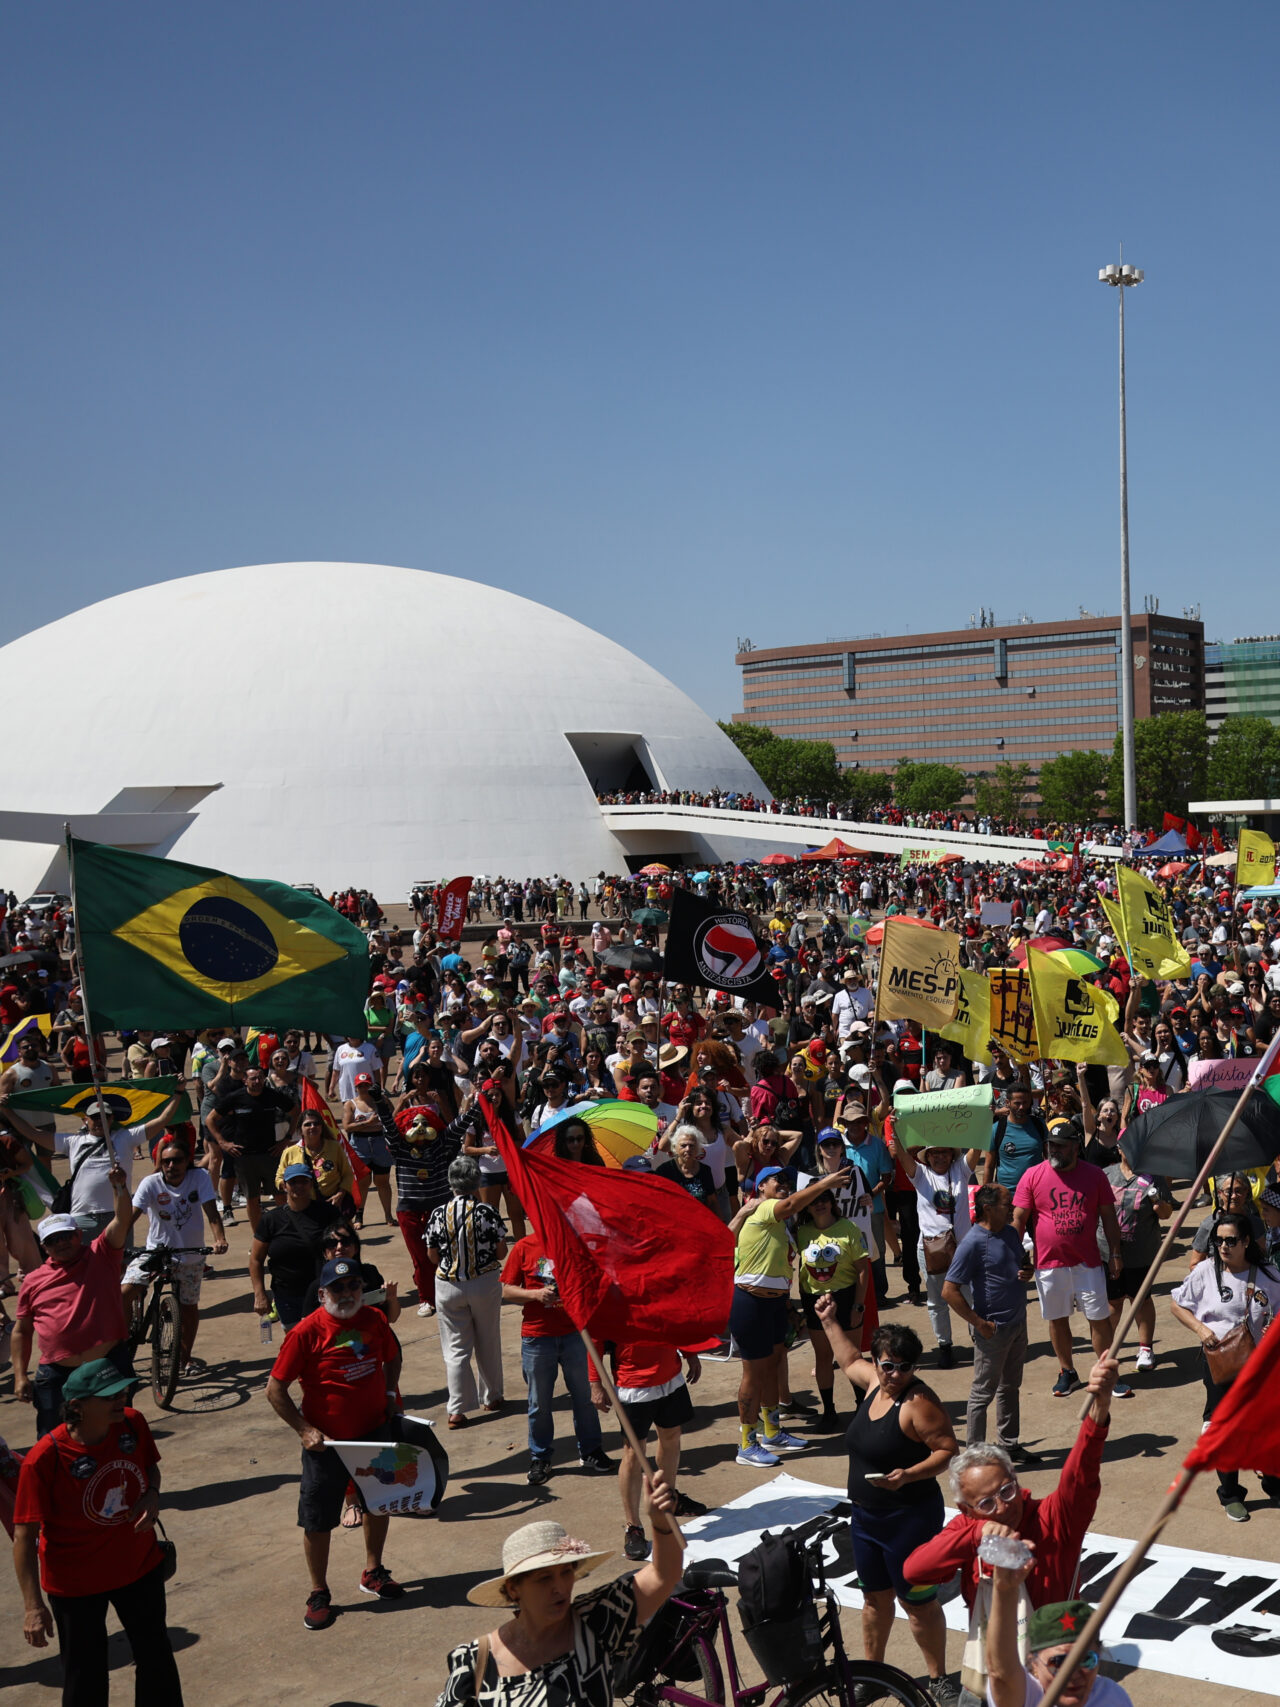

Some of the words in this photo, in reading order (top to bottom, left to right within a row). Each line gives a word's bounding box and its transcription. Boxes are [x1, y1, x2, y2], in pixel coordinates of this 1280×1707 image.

[910, 849, 930, 860] SEM
[440, 892, 454, 934] RICARDO
[452, 896, 462, 919] VALE
[699, 960, 752, 985] ANTIFASCISTA
[889, 966, 958, 997] MES-P
[990, 981, 1031, 997] GOLPI
[1054, 1016, 1098, 1038] juntos
[911, 1102, 967, 1114] INIMIGO
[954, 1110, 972, 1119] DO
[922, 1121, 969, 1137] POVO
[1050, 1187, 1086, 1211] SEM
[1054, 1219, 1081, 1227] PARA
